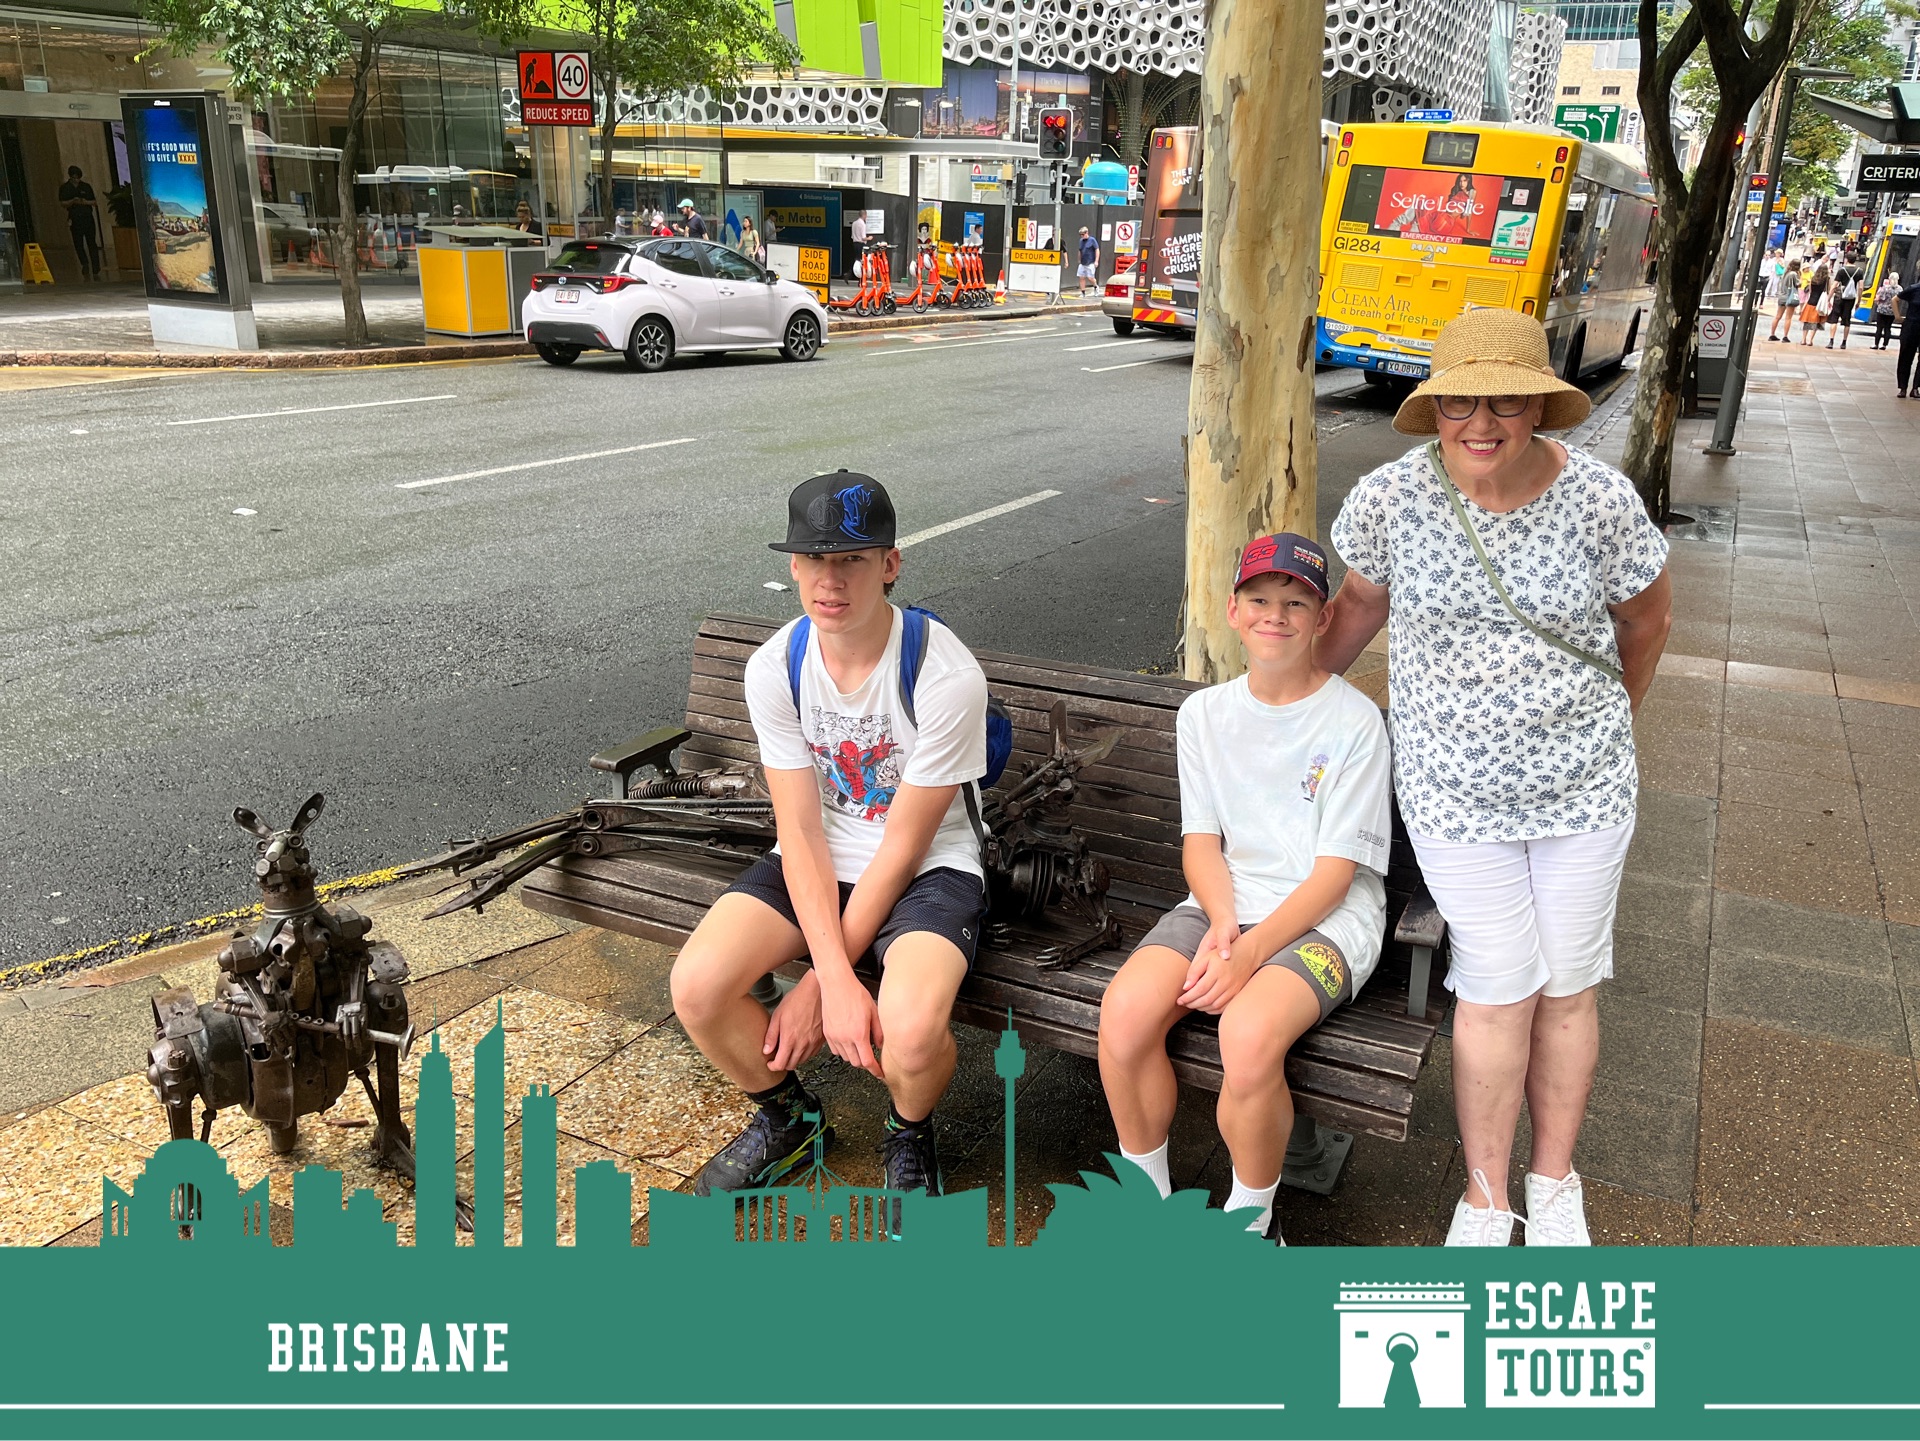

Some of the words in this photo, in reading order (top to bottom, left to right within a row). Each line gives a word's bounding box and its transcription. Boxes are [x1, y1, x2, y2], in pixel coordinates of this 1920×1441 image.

[562, 66, 584, 87] 40
[526, 107, 559, 120] REDUCE
[561, 108, 589, 121] SPEED
[161, 143, 178, 152] GOOD
[179, 143, 197, 152] WHEN
[157, 154, 171, 163] GIVE
[172, 154, 177, 163] A
[179, 154, 196, 163] XXXX
[1171, 169, 1187, 178] THE
[1863, 166, 1920, 179] CRITERI
[1171, 176, 1192, 187] CAN'
[1390, 192, 1434, 211] Selfie
[1437, 196, 1484, 215] Leslie
[788, 212, 822, 223] Metro
[1401, 232, 1444, 242] EMERGENCY
[1445, 236, 1463, 244] EXIT
[805, 249, 824, 260] SIDE
[1161, 246, 1181, 257] THE
[1182, 242, 1202, 253] GRE
[1410, 243, 1448, 254] MAN
[1014, 252, 1044, 260] DETOUR
[1169, 252, 1195, 266] HIGH
[802, 261, 826, 271] ROAD
[1163, 261, 1197, 276] CRUSH
[800, 272, 827, 281] CLOSED
[1331, 287, 1380, 309] CLEAN
[1384, 294, 1411, 313] AIR
[1340, 307, 1347, 315] a
[1350, 306, 1382, 320] breath
[1384, 312, 1396, 321] of
[1399, 312, 1428, 325] fresh
[1431, 318, 1448, 328] air
[1245, 544, 1279, 566] 33
